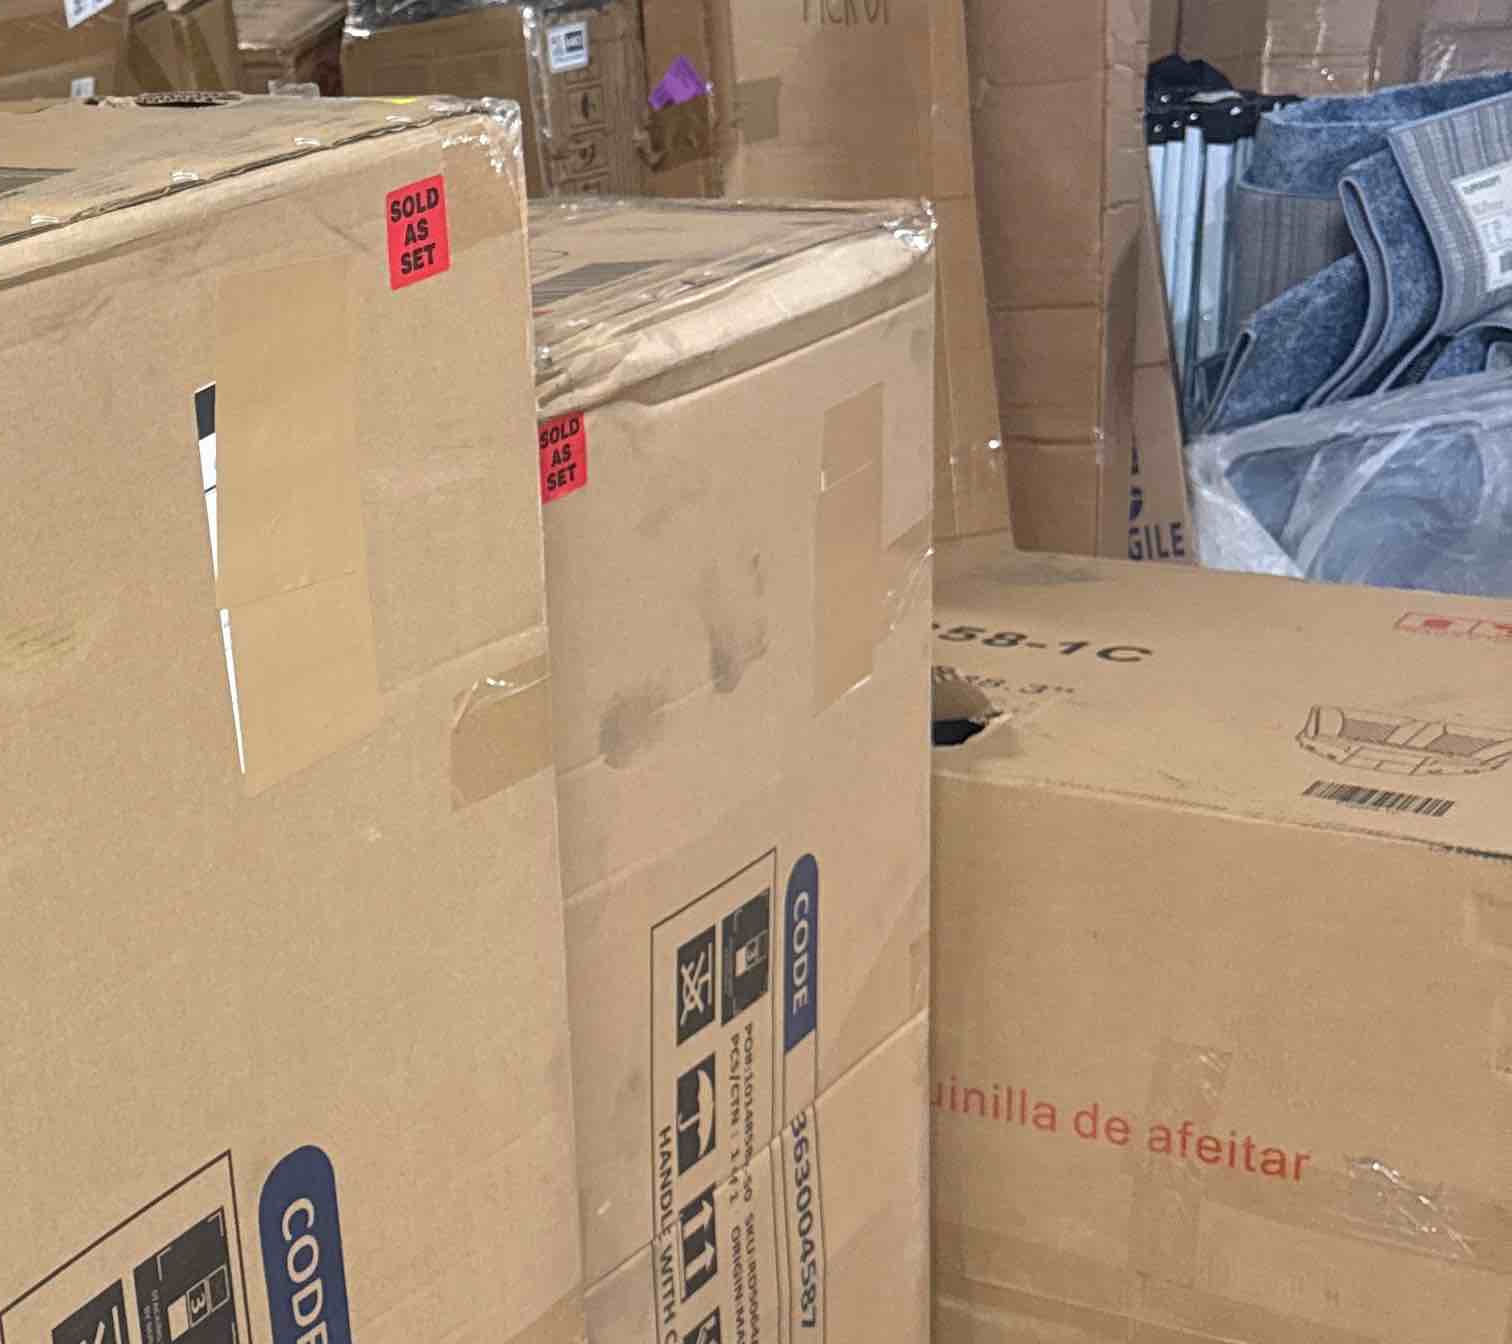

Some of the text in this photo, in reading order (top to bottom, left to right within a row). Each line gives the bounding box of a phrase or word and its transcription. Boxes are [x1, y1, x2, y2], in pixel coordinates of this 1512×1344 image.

[390, 187, 439, 223] SOLD
[404, 218, 429, 247] AS
[400, 243, 437, 276] SET
[539, 417, 580, 450] SOLD
[551, 444, 572, 468] AS
[546, 463, 577, 492] SET
[932, 623, 1153, 663] 58-1C
[792, 891, 810, 1017] CODE
[1073, 1102, 1132, 1147] de
[1148, 1120, 1312, 1184] afeitar
[658, 1124, 674, 1242] HANDLE
[790, 1110, 817, 1329] 363004587
[660, 1245, 677, 1324] WITH
